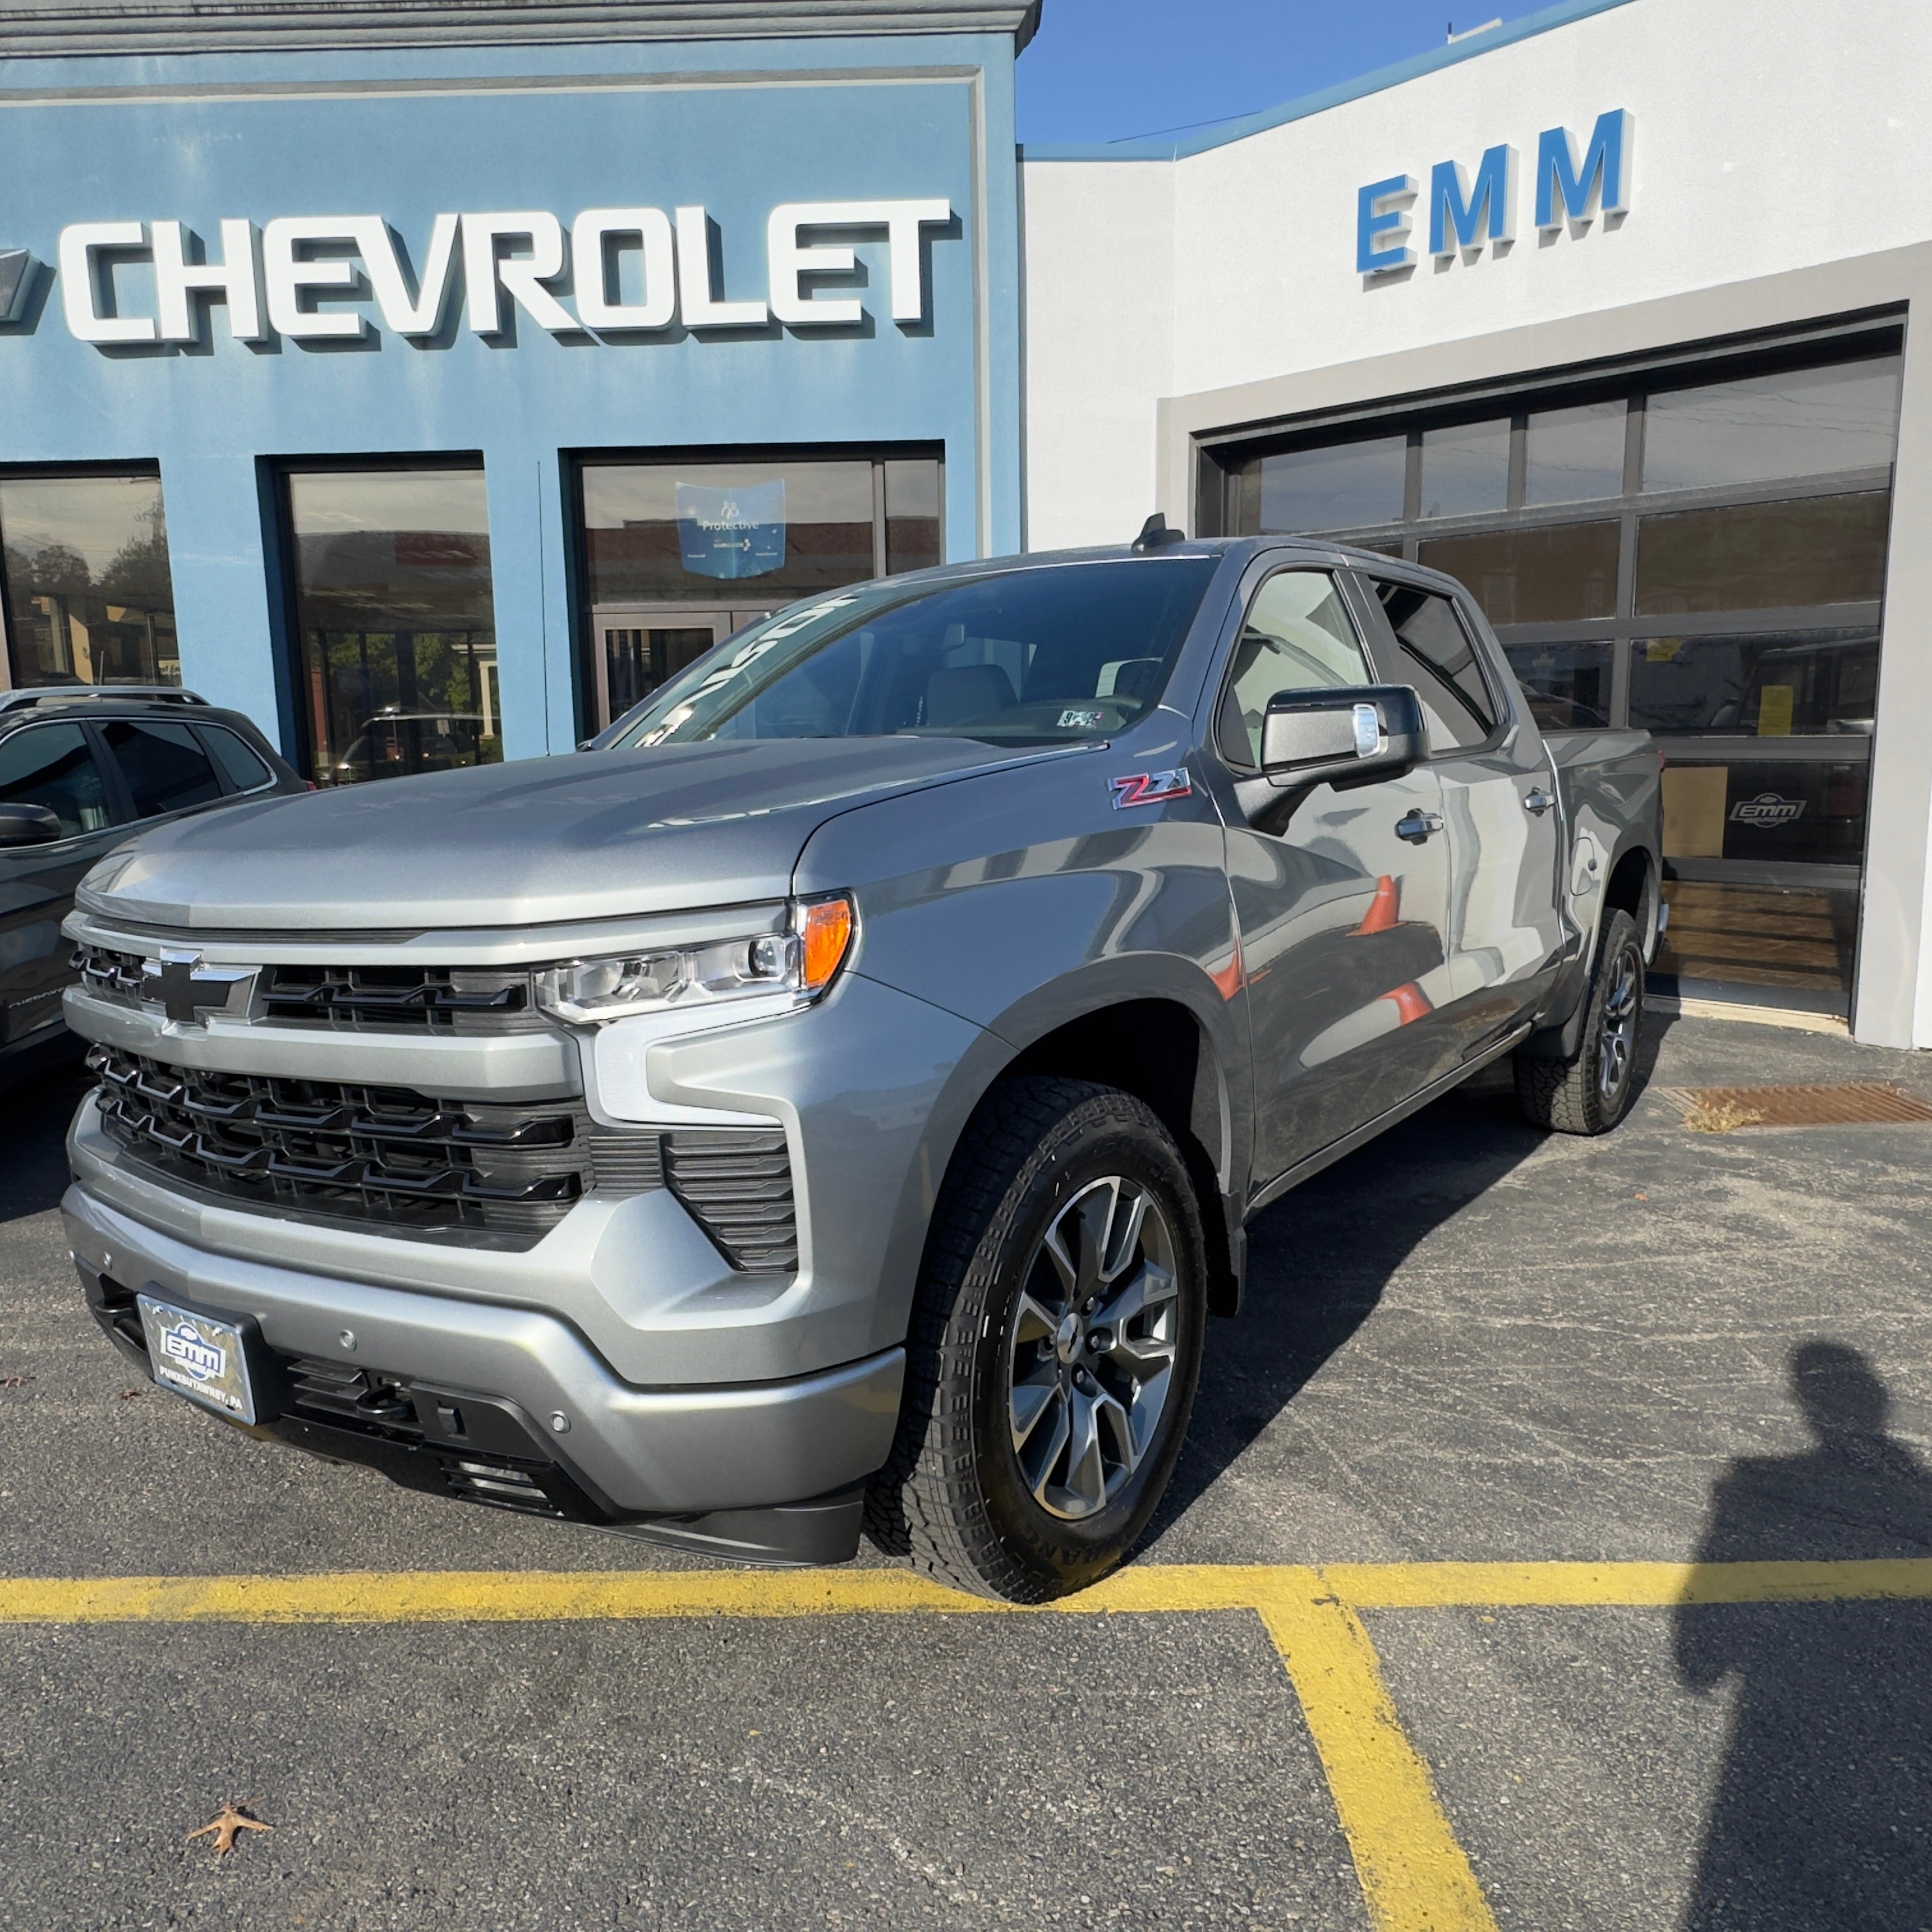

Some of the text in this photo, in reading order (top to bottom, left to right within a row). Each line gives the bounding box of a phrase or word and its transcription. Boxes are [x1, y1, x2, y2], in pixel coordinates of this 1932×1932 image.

[1356, 107, 1629, 273] EMM
[57, 198, 951, 344] CHEVROLET
[702, 519, 760, 532] Protective
[1107, 767, 1192, 811] Z71
